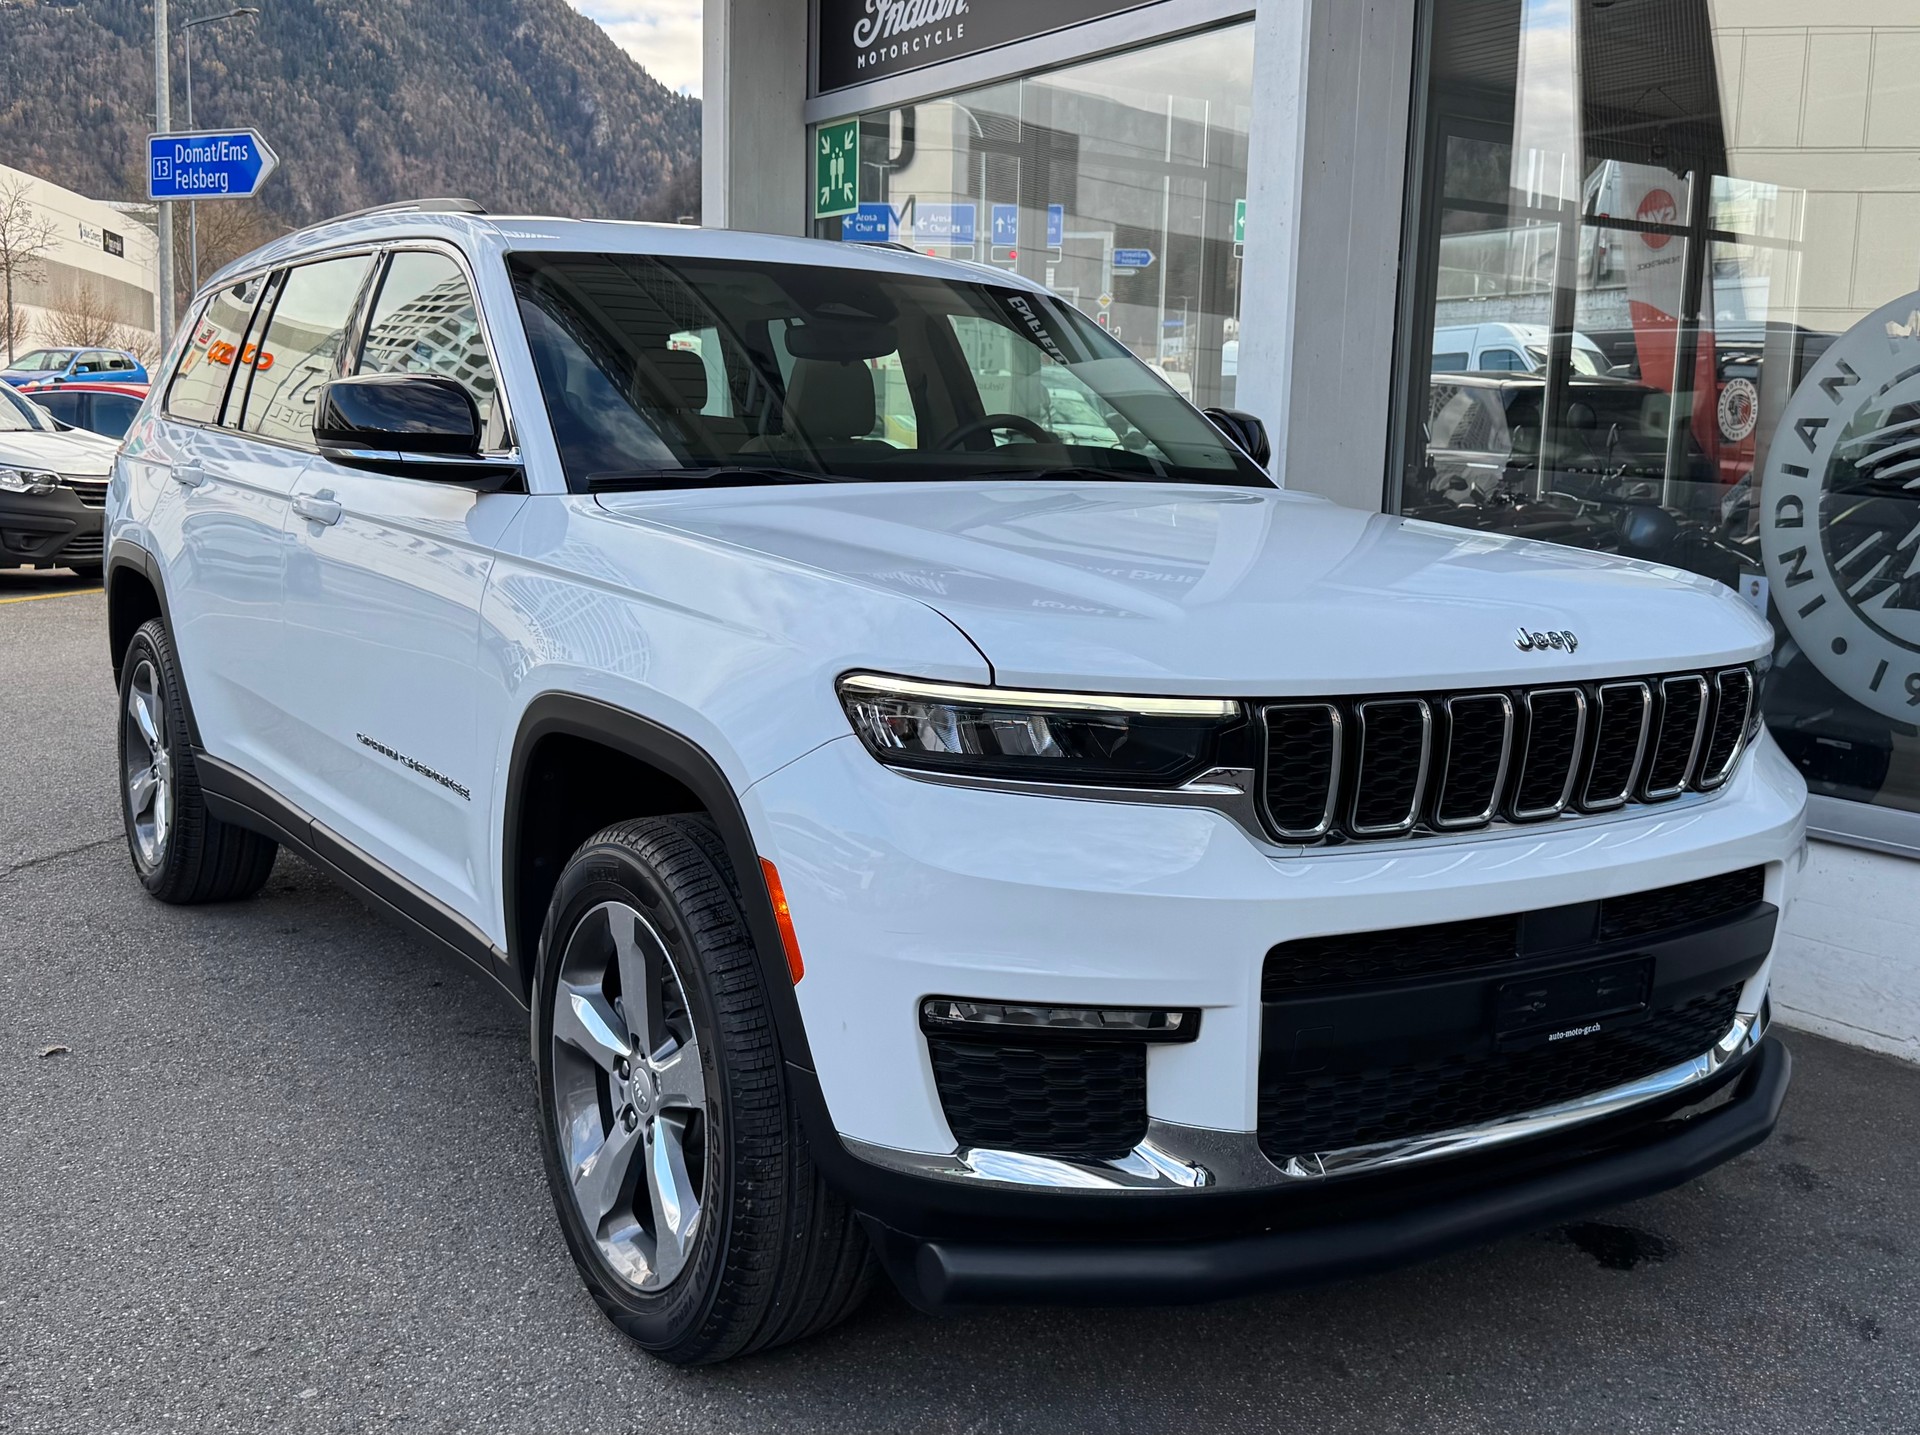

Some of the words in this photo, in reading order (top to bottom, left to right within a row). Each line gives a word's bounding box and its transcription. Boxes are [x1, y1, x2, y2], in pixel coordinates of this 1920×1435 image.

[857, 23, 964, 69] MOTORCYCLE
[175, 141, 249, 164] Domat/Ems
[156, 160, 169, 176] 13
[175, 167, 229, 193] Felsberg
[855, 213, 878, 222] Arosa
[855, 224, 873, 232] Chur
[1775, 357, 1862, 620] INDIAN
[1513, 627, 1579, 654] Jeep
[1548, 1021, 1601, 1042] auto-moto-gr.ch
[695, 1096, 722, 1291] SCORPION
